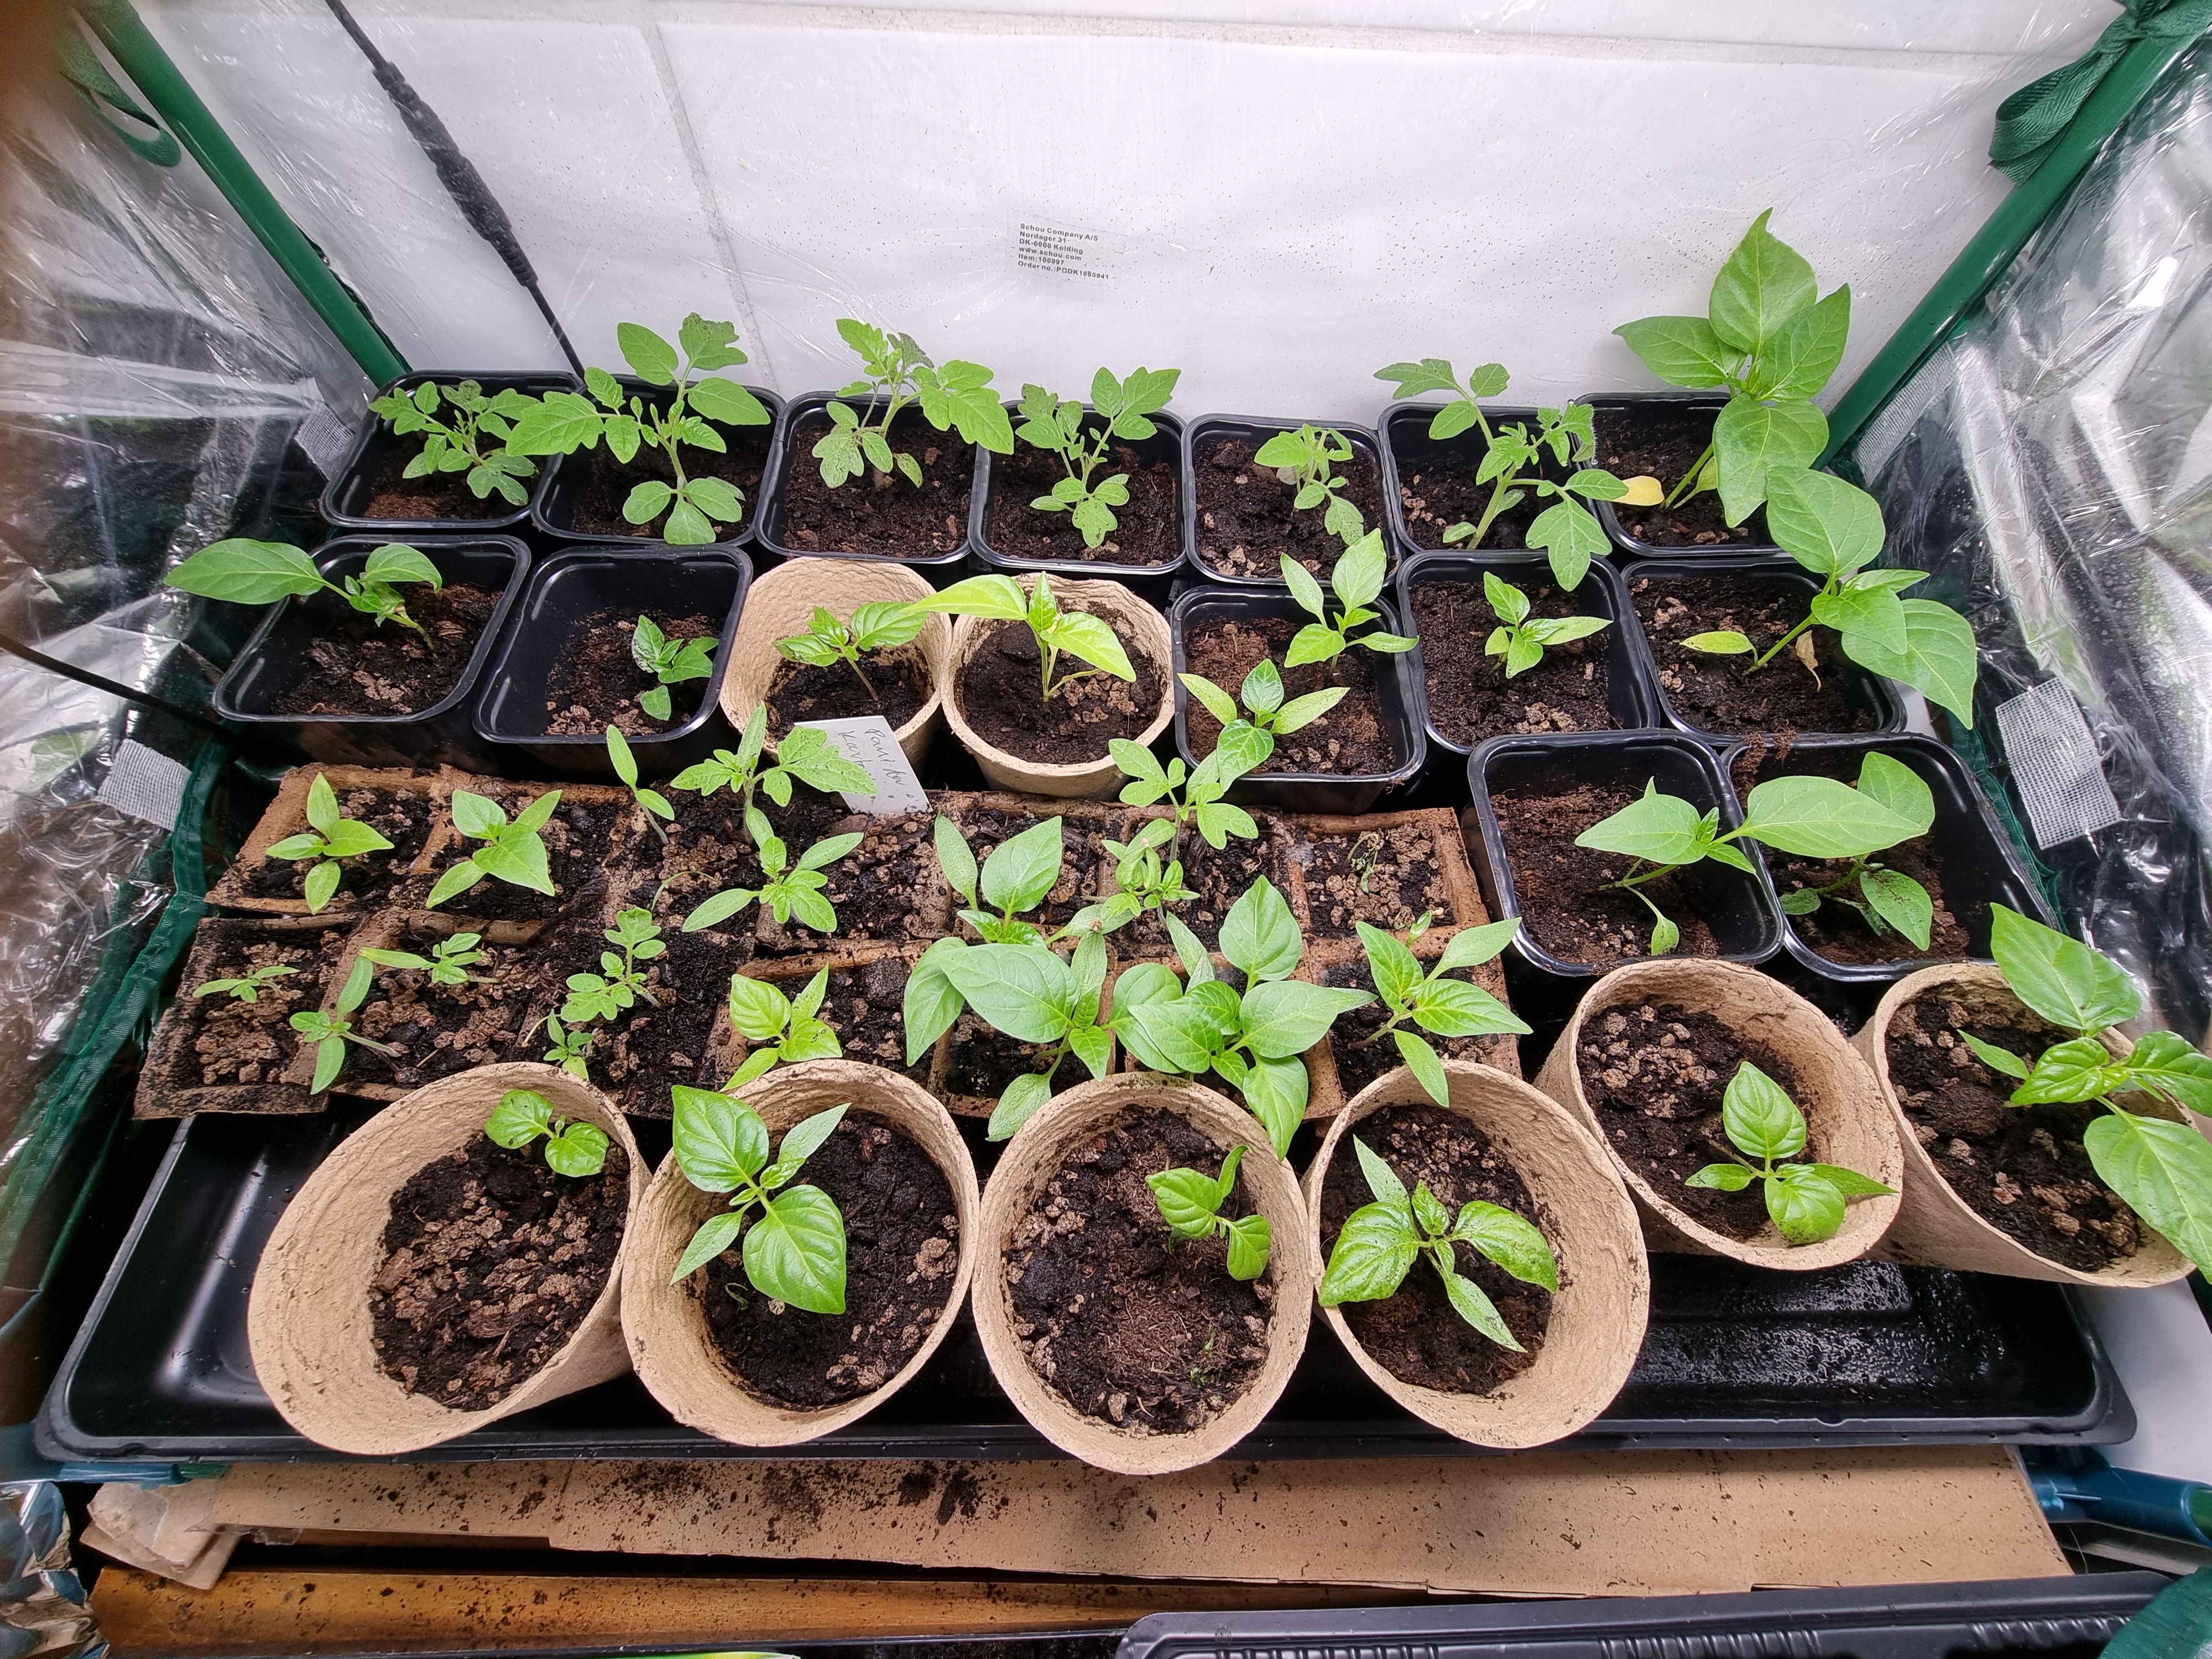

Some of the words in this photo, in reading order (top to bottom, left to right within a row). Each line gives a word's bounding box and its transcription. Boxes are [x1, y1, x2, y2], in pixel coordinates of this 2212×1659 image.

[1020, 223, 1045, 232] Schou
[1047, 227, 1083, 240] Company
[1019, 238, 1052, 249] DK-6000
[1053, 244, 1083, 255] Kolding
[1019, 247, 1081, 261] www.schou.com
[1018, 260, 1040, 269] Order
